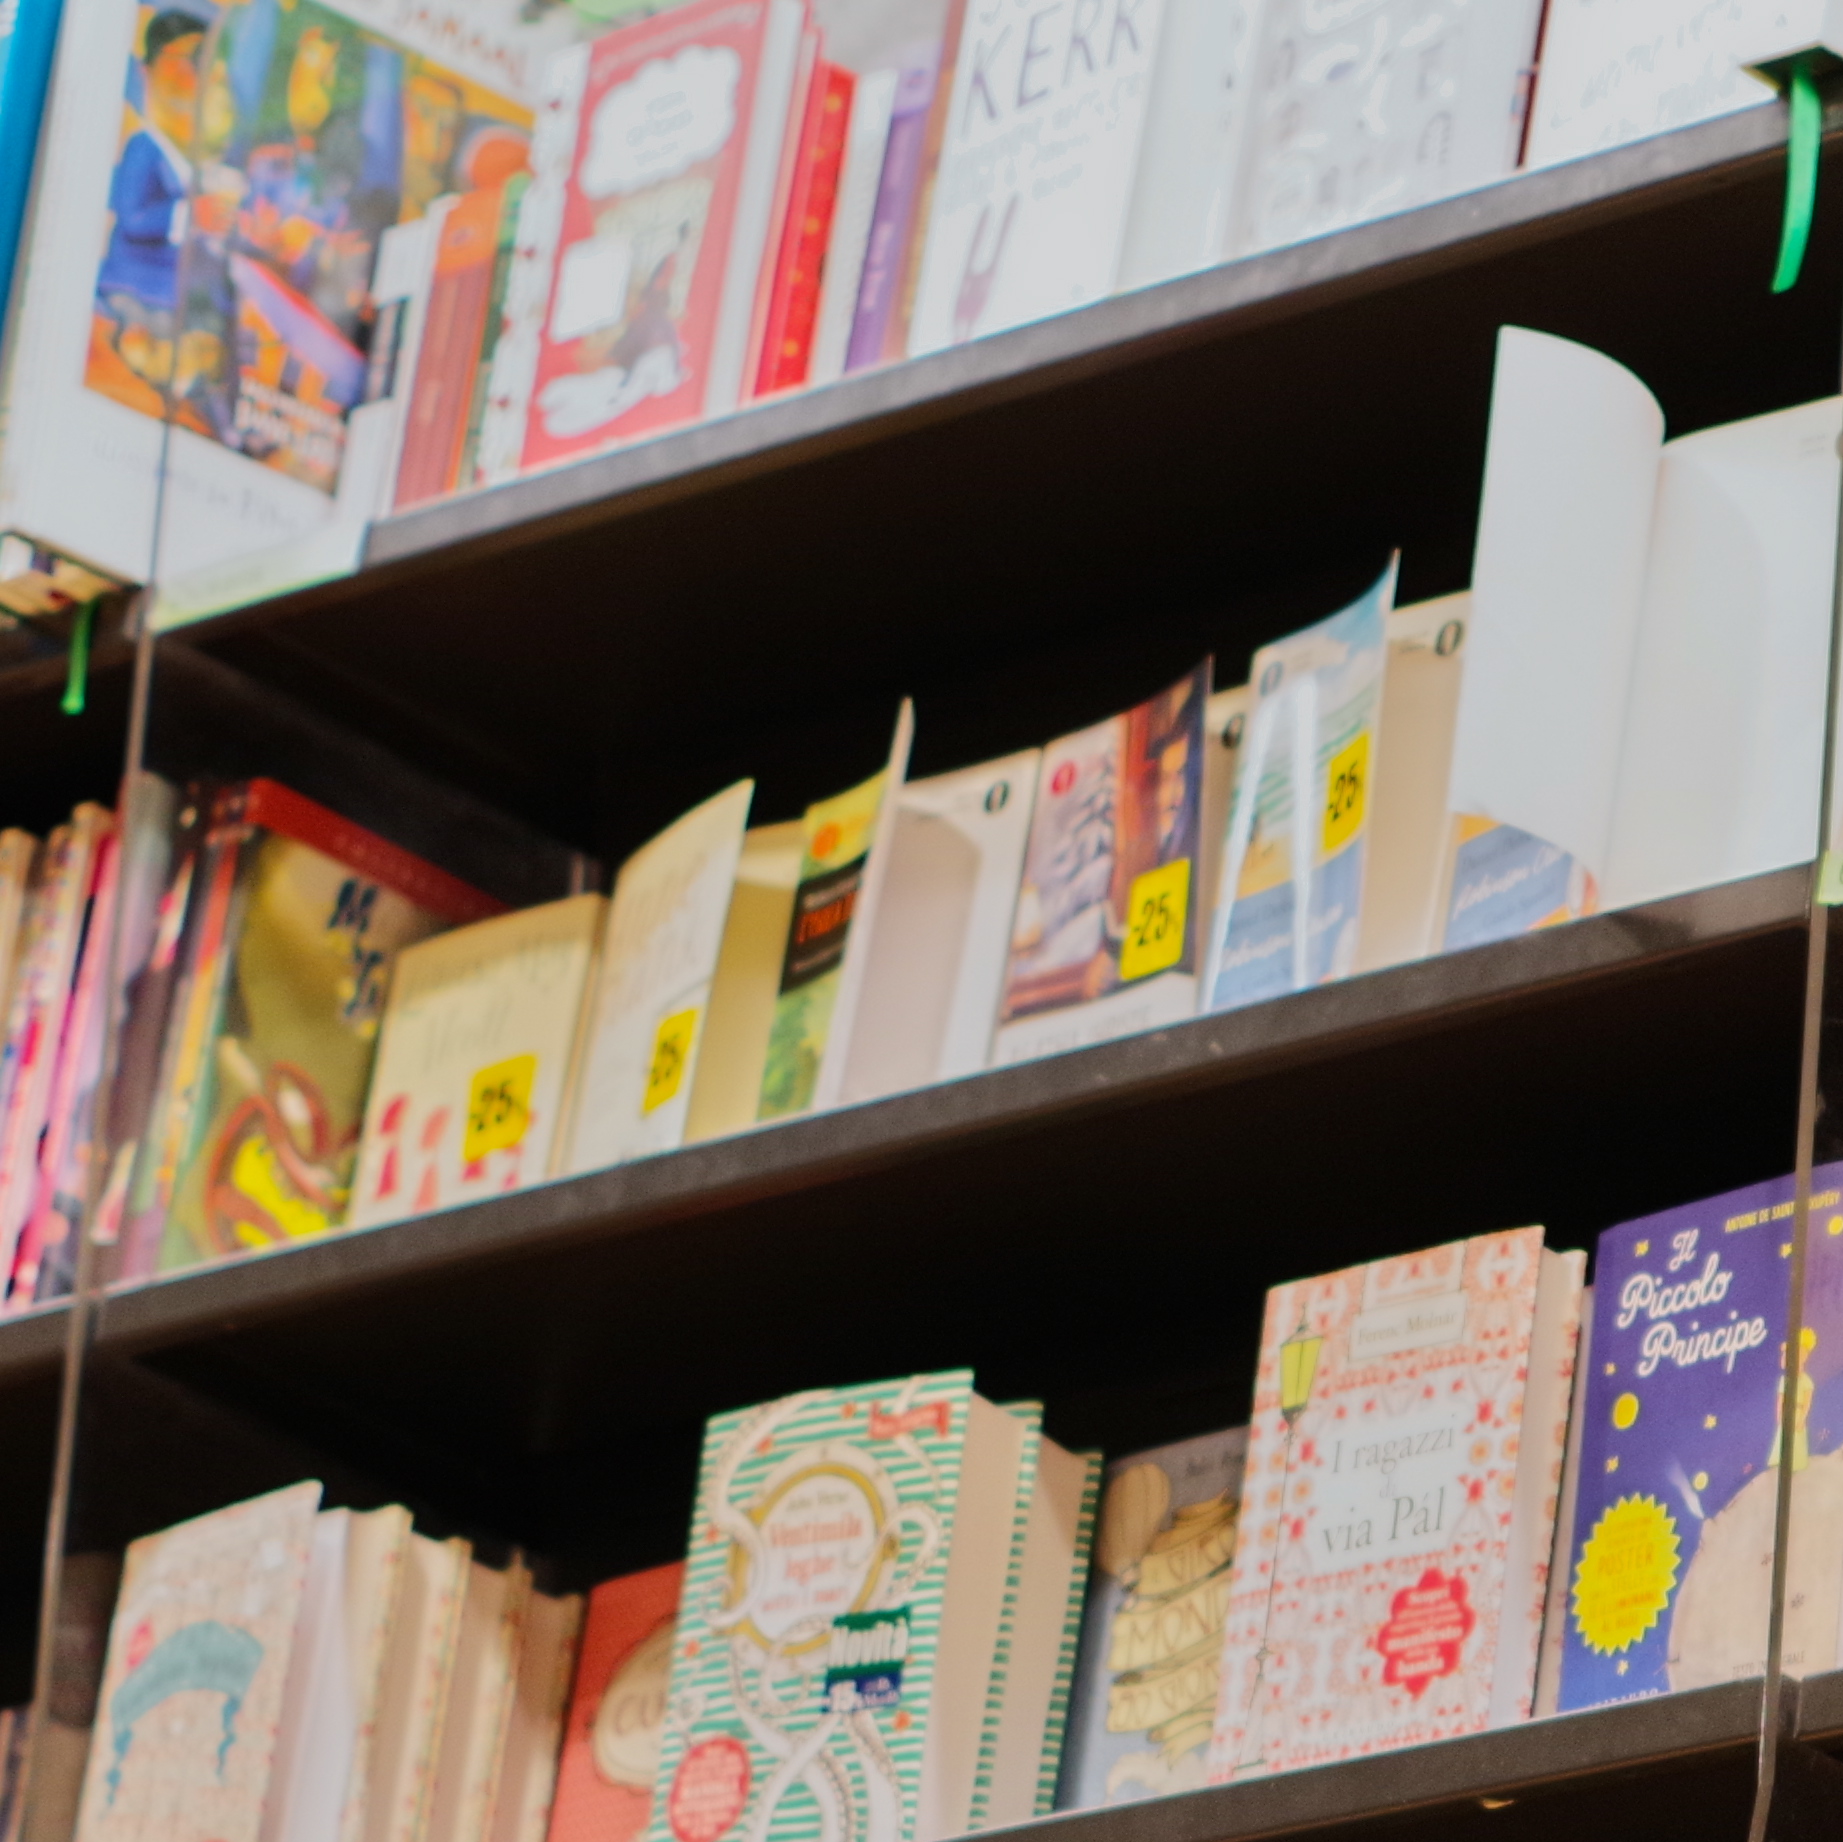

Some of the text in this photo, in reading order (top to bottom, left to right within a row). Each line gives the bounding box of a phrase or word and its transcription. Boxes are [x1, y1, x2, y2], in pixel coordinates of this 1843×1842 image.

[1616, 1252, 1732, 1328] Piccolo
[1636, 1316, 1769, 1378] Principe
[1351, 1425, 1456, 1470] ragazzi
[1322, 1488, 1446, 1555] via Pál
